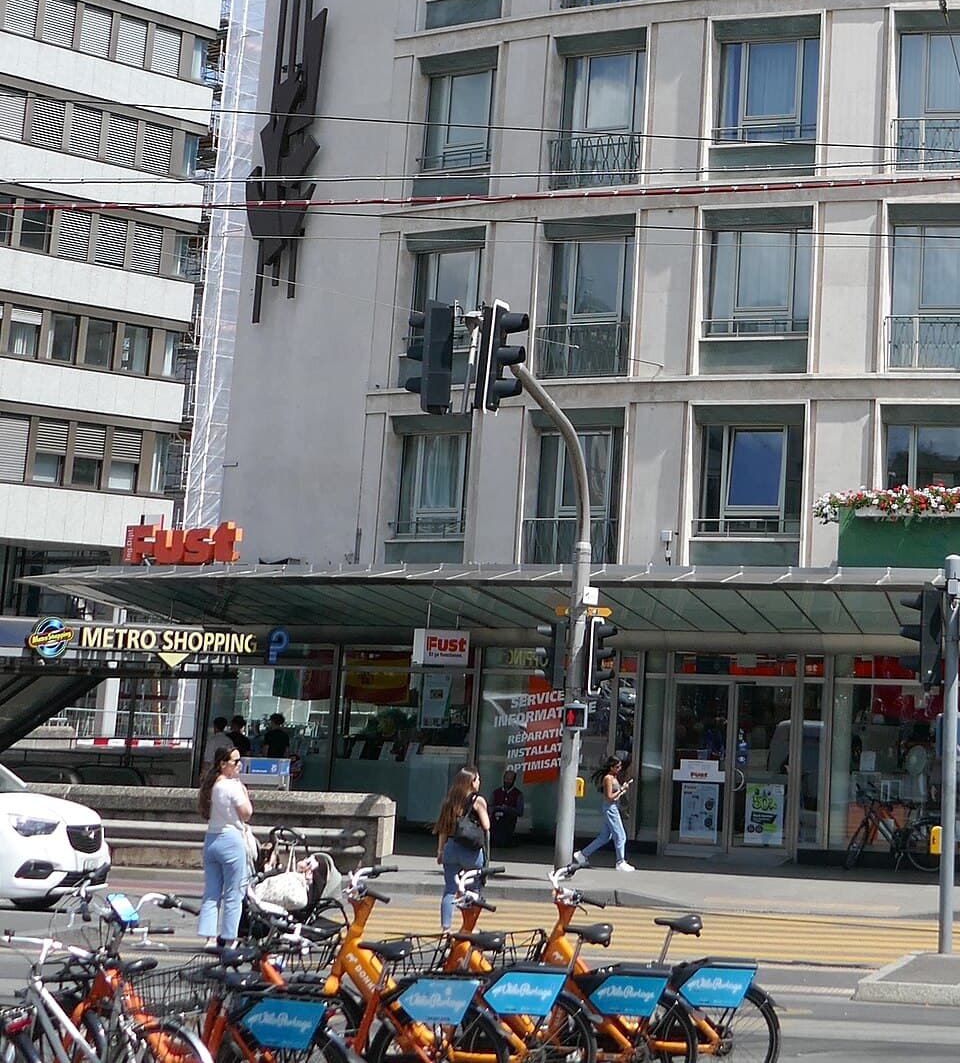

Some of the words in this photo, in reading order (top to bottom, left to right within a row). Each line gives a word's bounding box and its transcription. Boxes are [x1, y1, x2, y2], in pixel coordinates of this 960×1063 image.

[131, 521, 242, 565] Fust
[81, 626, 157, 650] METRO
[161, 630, 257, 653] SHOPPING
[426, 635, 467, 653] Fust
[510, 689, 565, 709] SERVICE
[493, 700, 597, 728] INFORMATE
